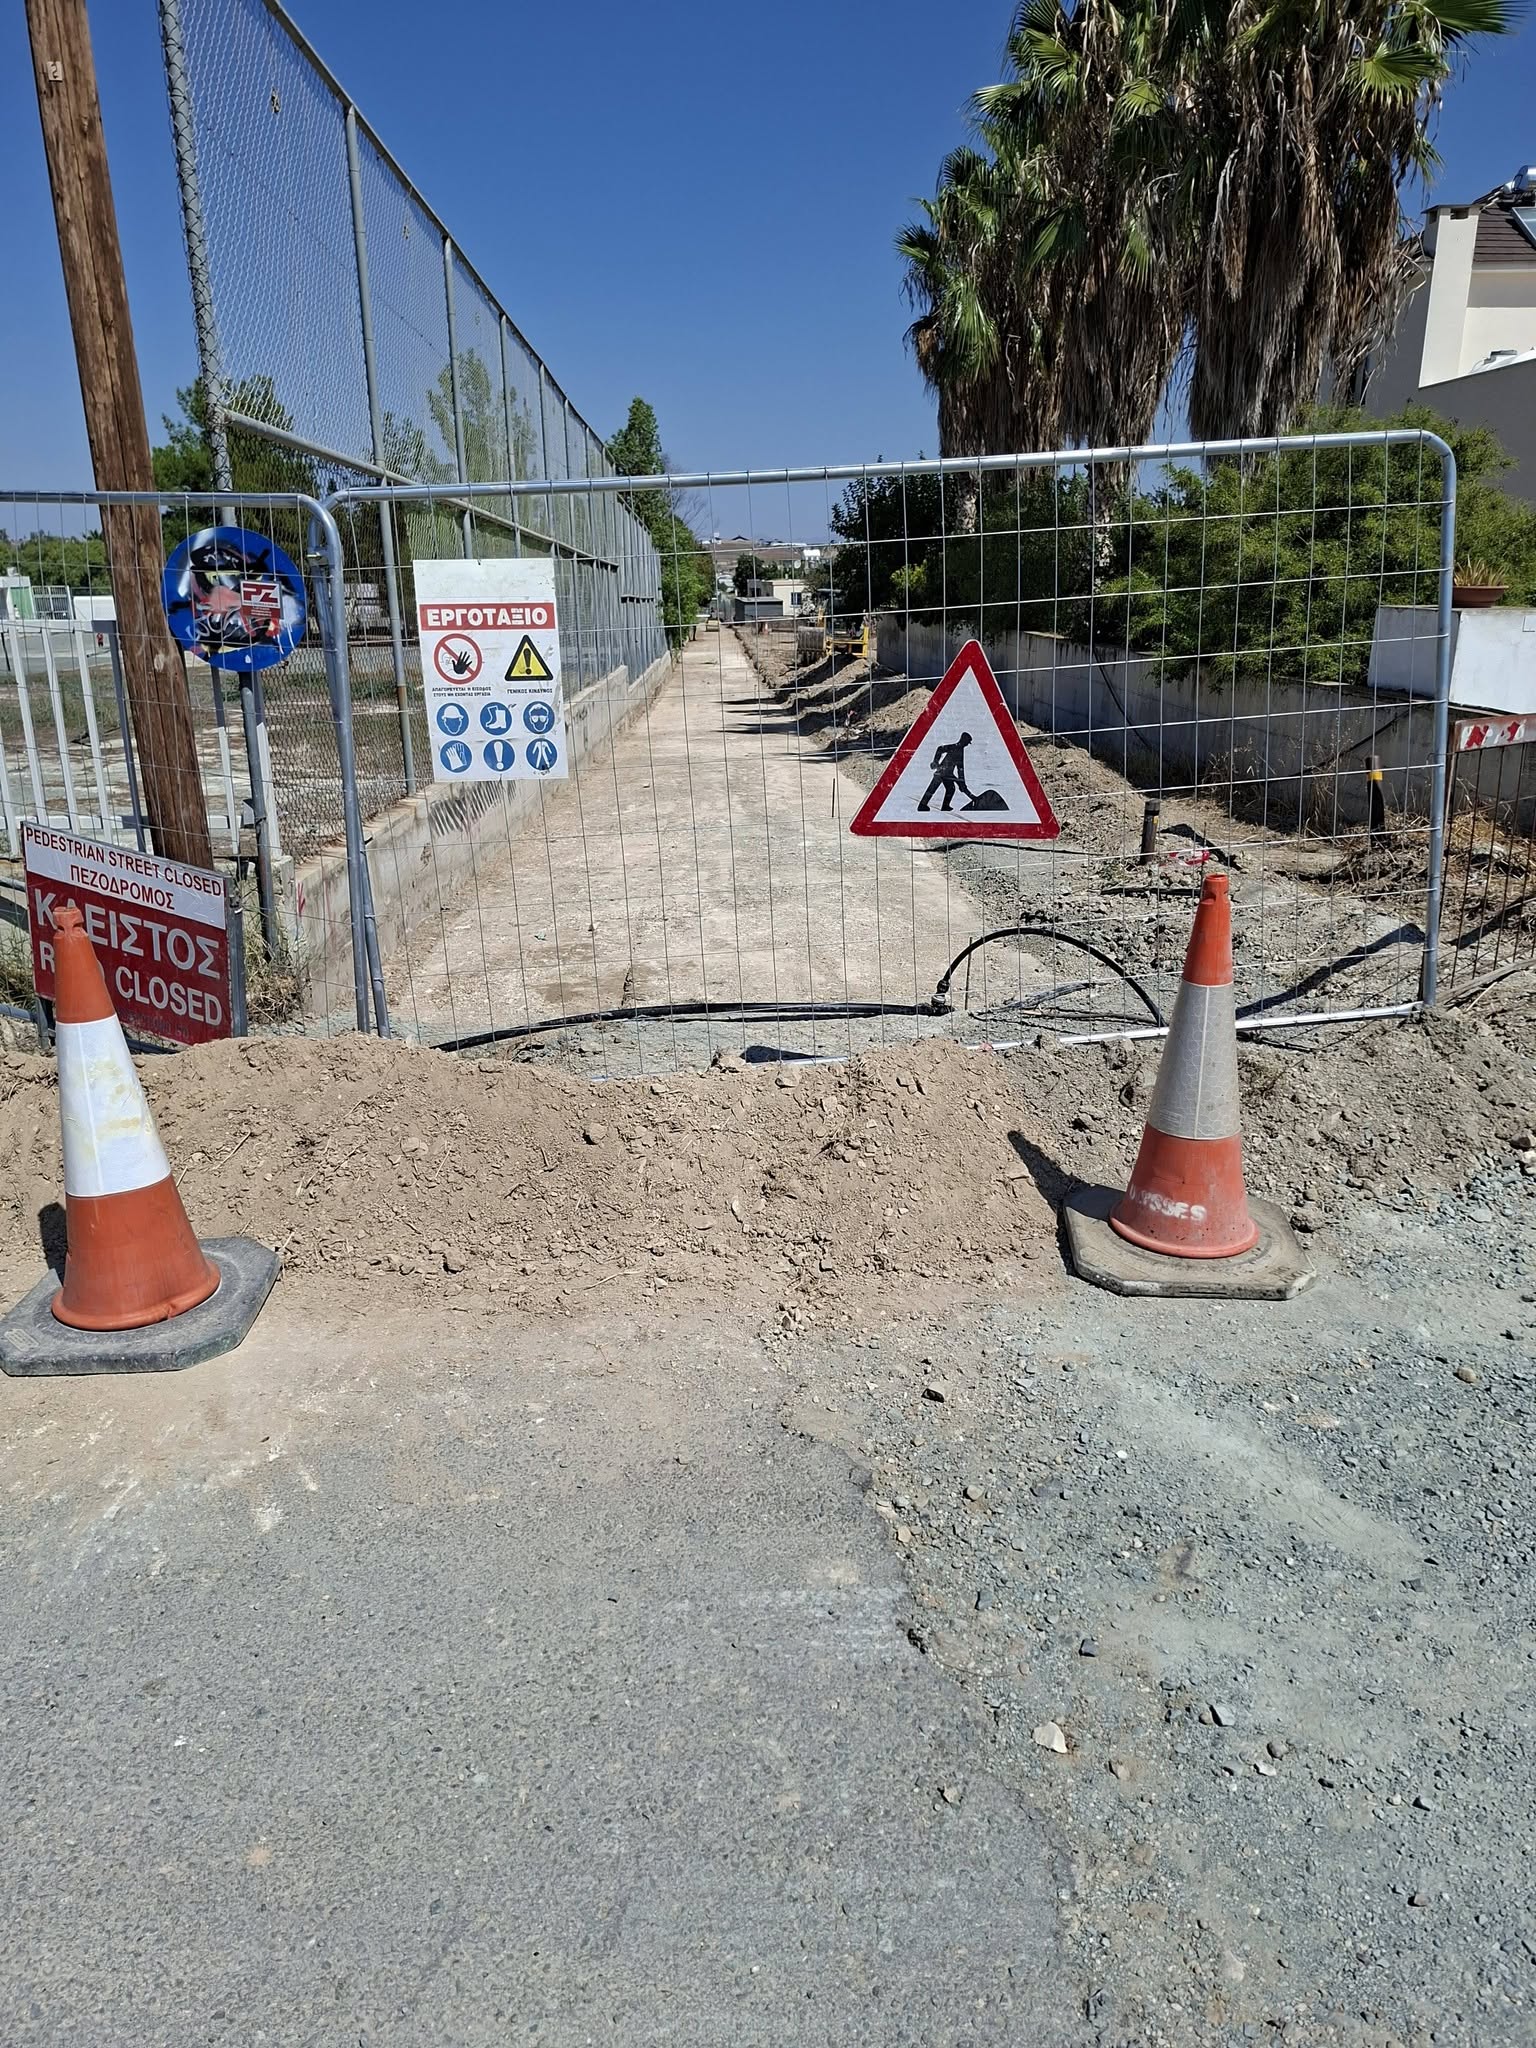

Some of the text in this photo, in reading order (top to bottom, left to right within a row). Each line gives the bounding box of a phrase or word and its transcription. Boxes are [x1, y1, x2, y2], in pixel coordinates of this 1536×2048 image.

[426, 607, 548, 627] ΕΡΓΟΤΑΞΙΟ
[26, 827, 222, 897] PEDESTRIAN STREET CLOSED
[70, 864, 175, 910] ΠΕΖΟΔΡΟΜΟΣ
[115, 965, 223, 1026] CLOSED
